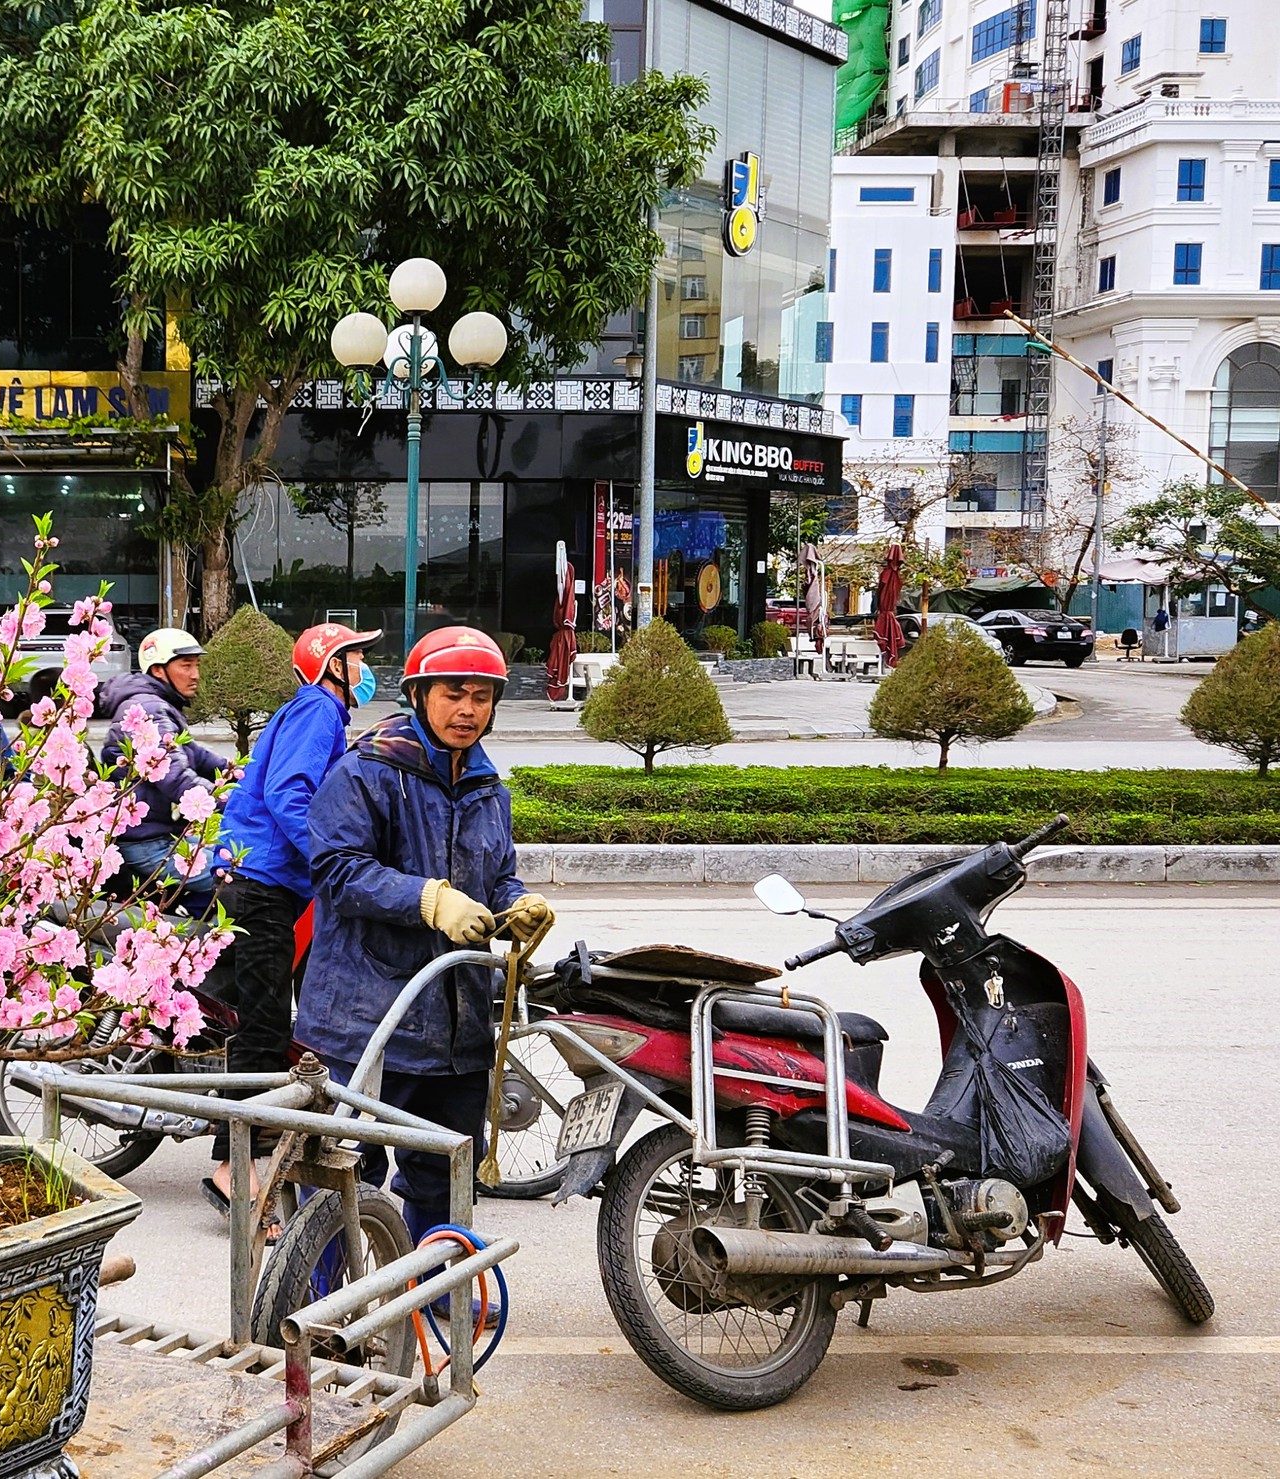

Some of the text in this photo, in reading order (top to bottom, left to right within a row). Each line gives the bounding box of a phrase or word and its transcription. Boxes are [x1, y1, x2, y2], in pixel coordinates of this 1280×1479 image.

[35, 386, 98, 420] LAM
[708, 438, 753, 466] KING
[754, 444, 793, 471] BBQ
[793, 460, 825, 473] BUFFET
[1007, 1058, 1044, 1070] ONDA
